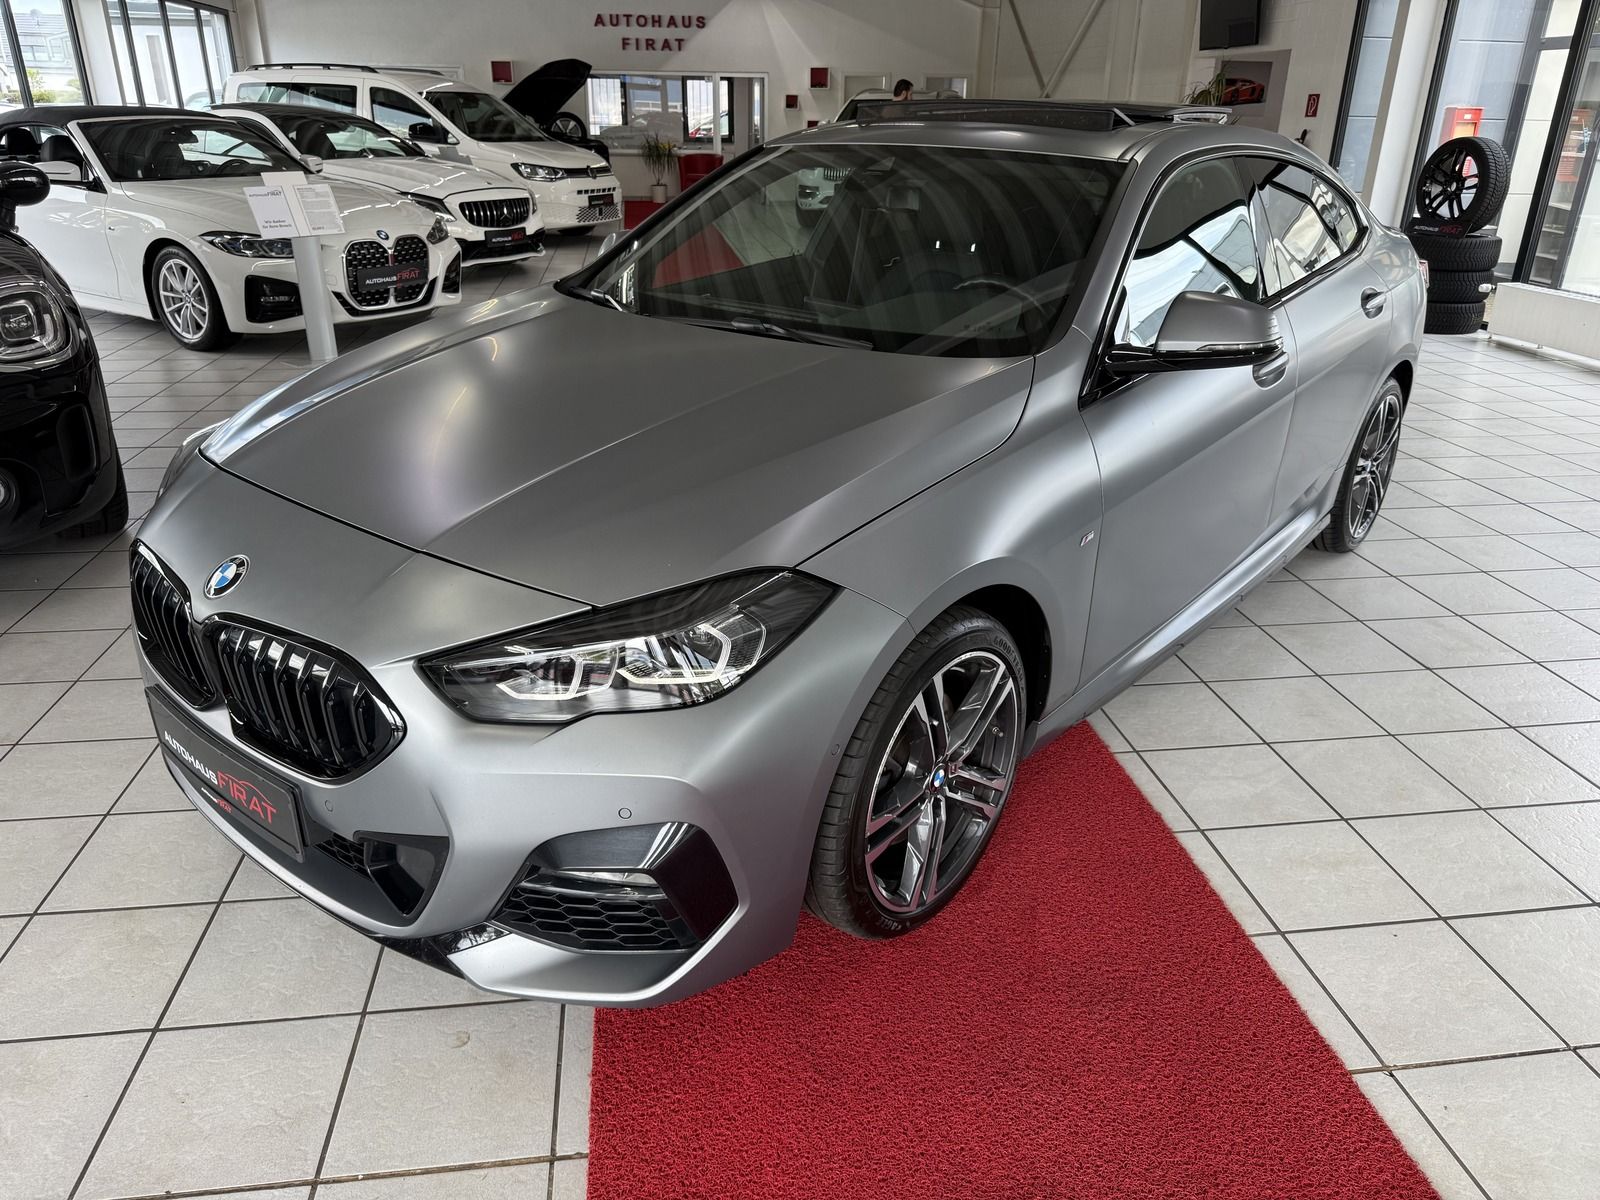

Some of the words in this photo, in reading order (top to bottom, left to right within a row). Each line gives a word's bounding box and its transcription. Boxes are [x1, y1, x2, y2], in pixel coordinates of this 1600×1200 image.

[594, 14, 706, 29] AUTOHAUS
[621, 37, 685, 51] FIRAT
[365, 275, 397, 285] AUTOHAUS
[396, 269, 420, 280] FIRAT
[164, 730, 218, 784] AUTOHAUS
[217, 771, 277, 824] FIRAT
